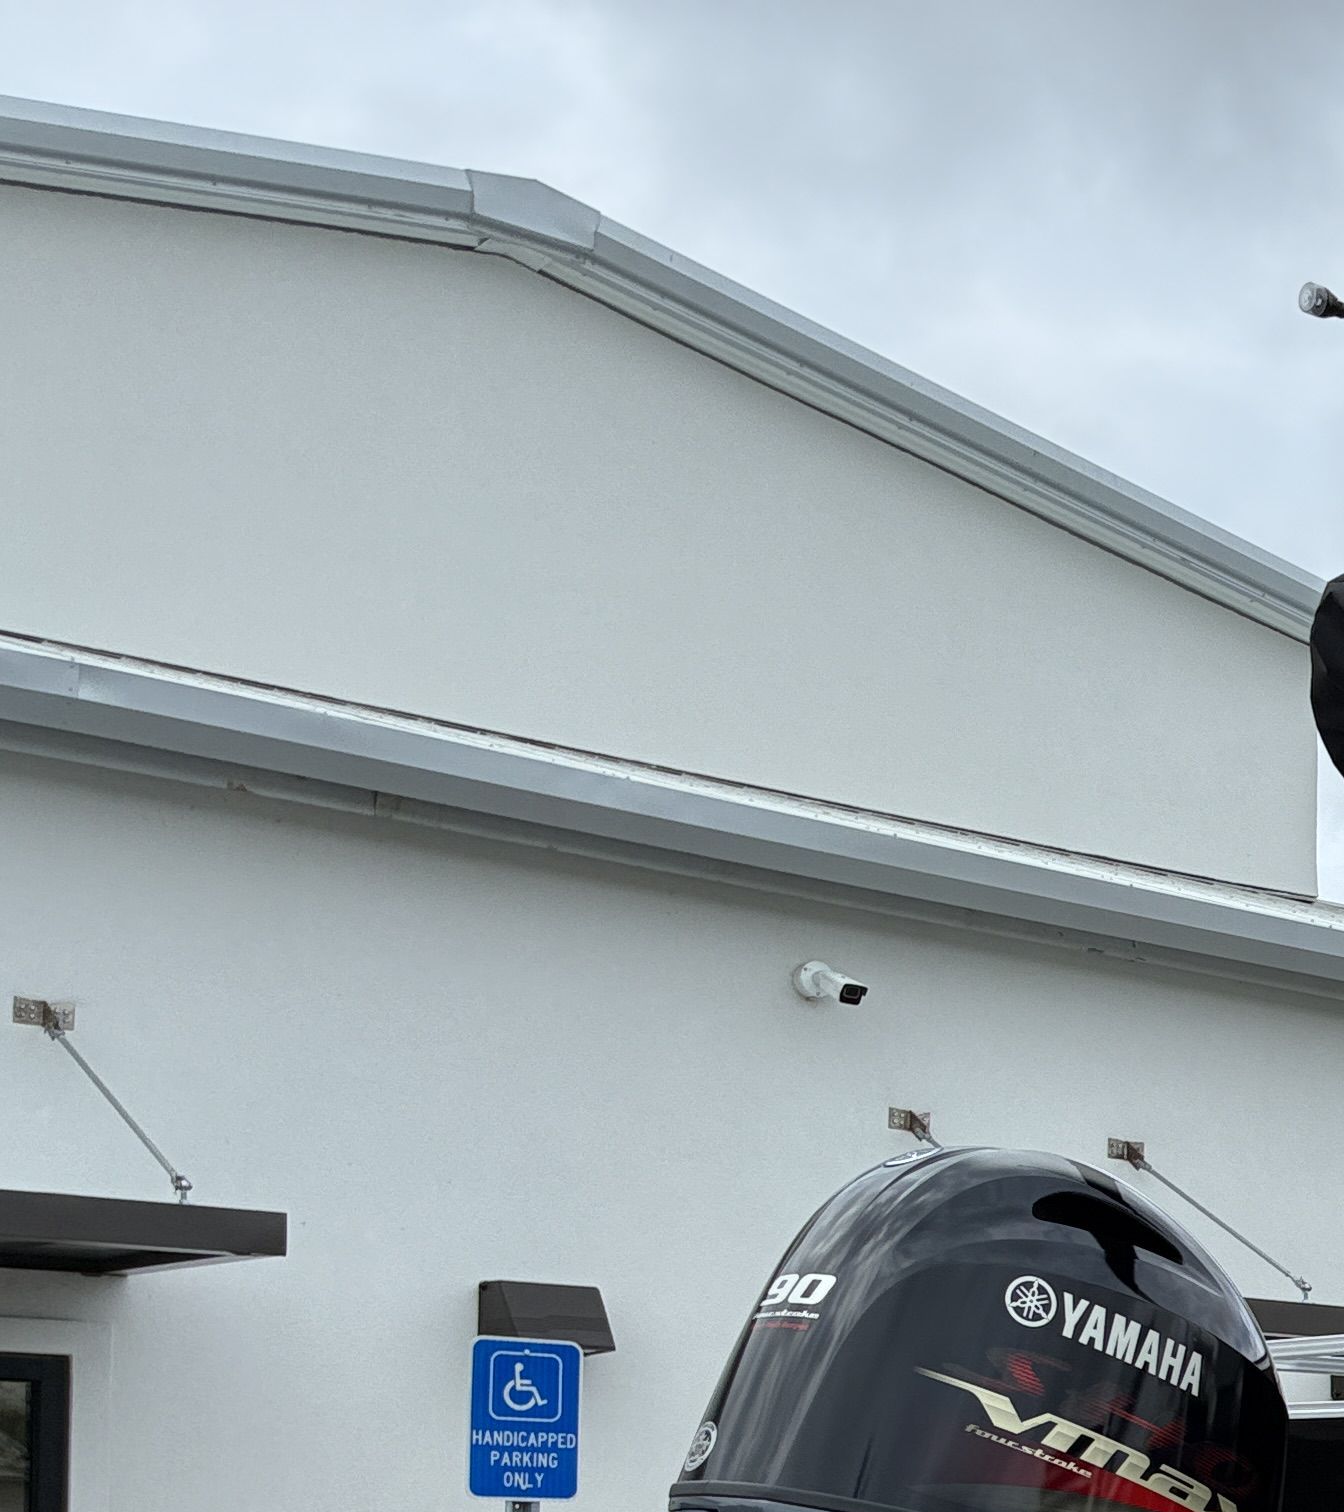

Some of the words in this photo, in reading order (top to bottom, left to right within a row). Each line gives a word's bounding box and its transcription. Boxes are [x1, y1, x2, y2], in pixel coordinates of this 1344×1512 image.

[760, 1273, 837, 1307] 90
[1062, 1292, 1204, 1398] YAMAHA
[472, 1430, 577, 1449] HANDICAPPED
[490, 1450, 559, 1469] PARKING
[503, 1471, 545, 1490] ONLY
